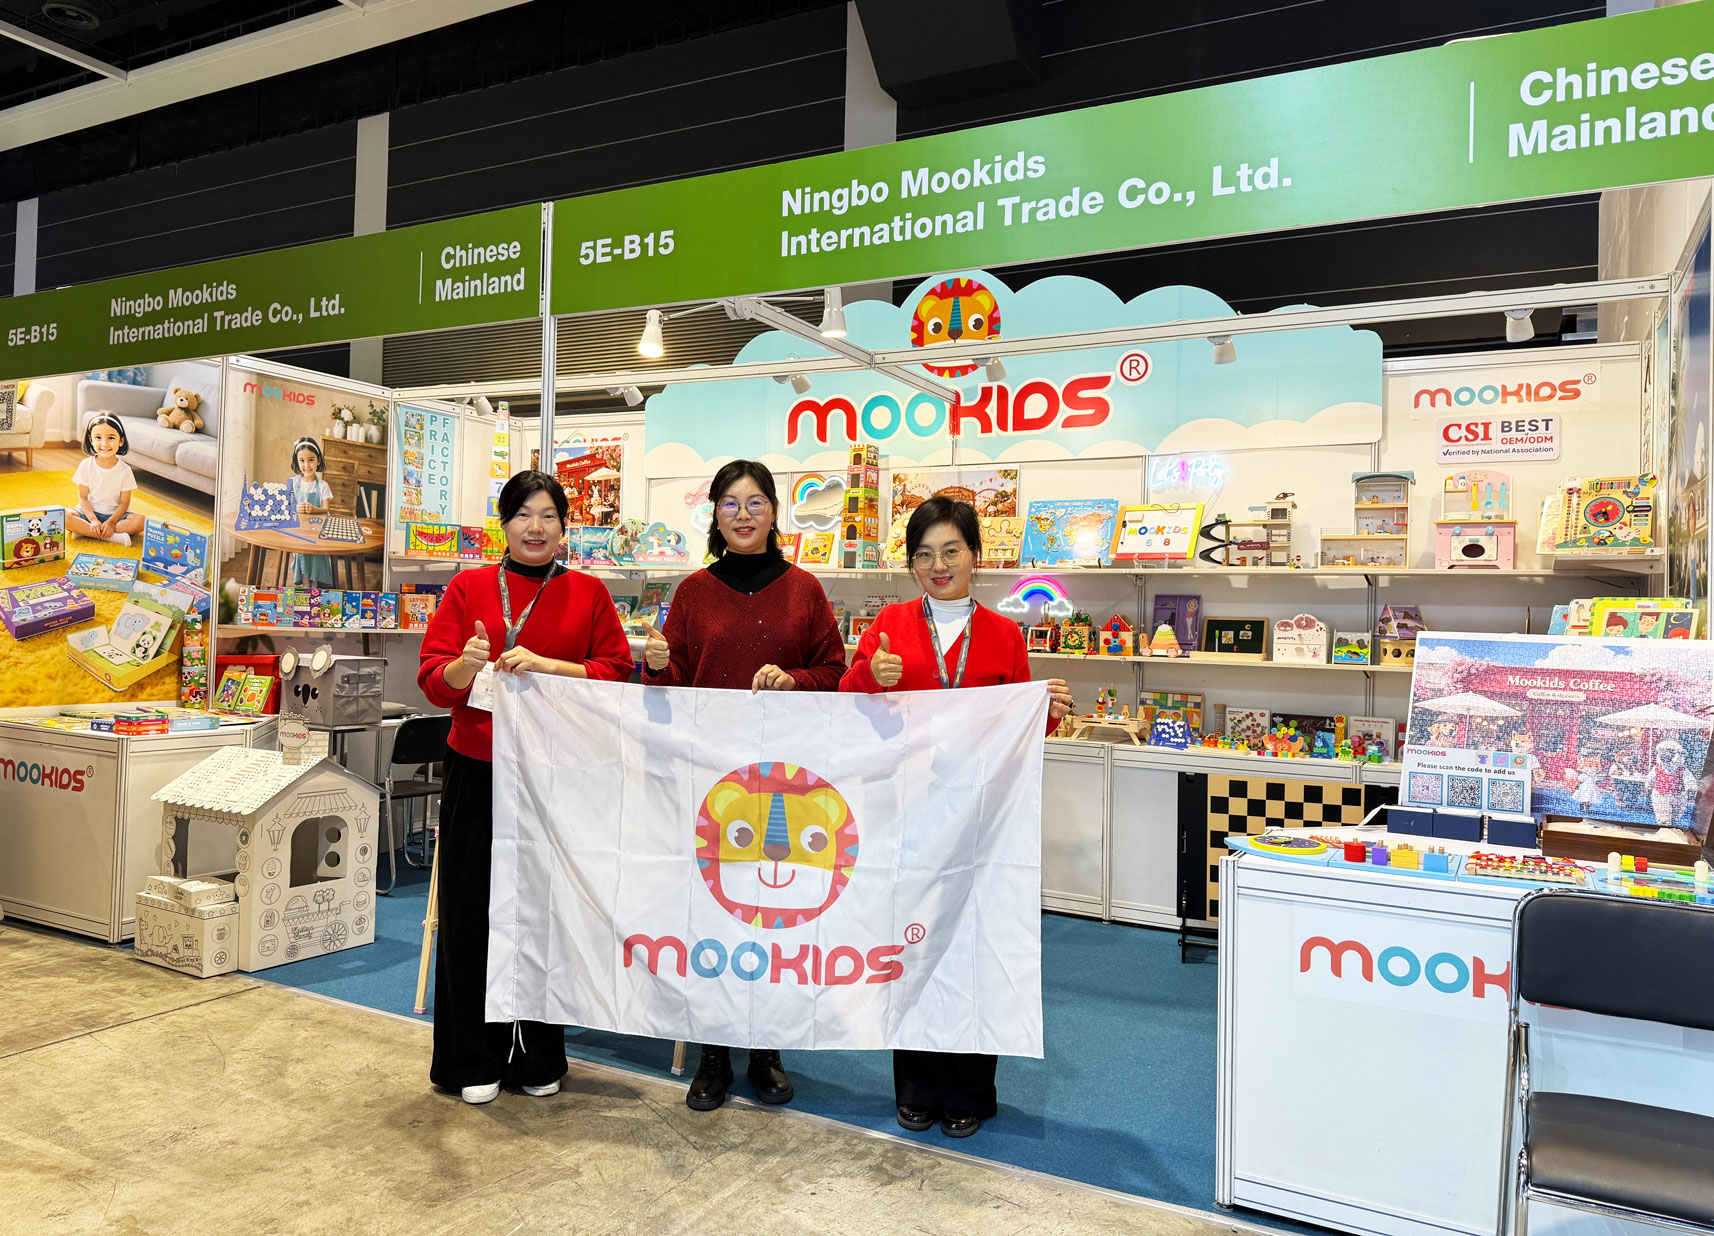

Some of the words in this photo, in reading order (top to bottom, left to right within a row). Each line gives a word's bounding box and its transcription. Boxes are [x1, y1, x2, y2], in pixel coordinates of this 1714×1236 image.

[1520, 52, 1714, 106] Chinese
[782, 179, 890, 217] Ningbo
[901, 150, 1046, 199] Mookids
[781, 195, 985, 257] International
[997, 186, 1104, 226] Trade
[1118, 177, 1196, 209] Co.,
[1212, 156, 1293, 197] Ltd.
[440, 241, 521, 270] Chinese
[579, 229, 676, 265] 5E-B15
[435, 267, 525, 302] Mainland
[110, 293, 164, 318] Ningbo
[168, 280, 237, 308] Mookids
[109, 310, 208, 345] International
[213, 306, 263, 331] Trade
[268, 302, 303, 324] Co.,
[309, 293, 346, 318] Ltd.
[8, 323, 58, 347] 5E-B15
[1442, 421, 1493, 443] CSI
[1500, 418, 1554, 434] BEST
[1471, 448, 1480, 456] by
[1480, 446, 1511, 455] National
[1511, 445, 1554, 454] Association
[1500, 435, 1554, 446] OEM/ODM
[1127, 525, 1189, 536] MOOKIDS
[1506, 675, 1567, 689] Mookids
[1569, 678, 1616, 692] Coffee
[1416, 762, 1438, 770] Please
[1467, 765, 1484, 773] code
